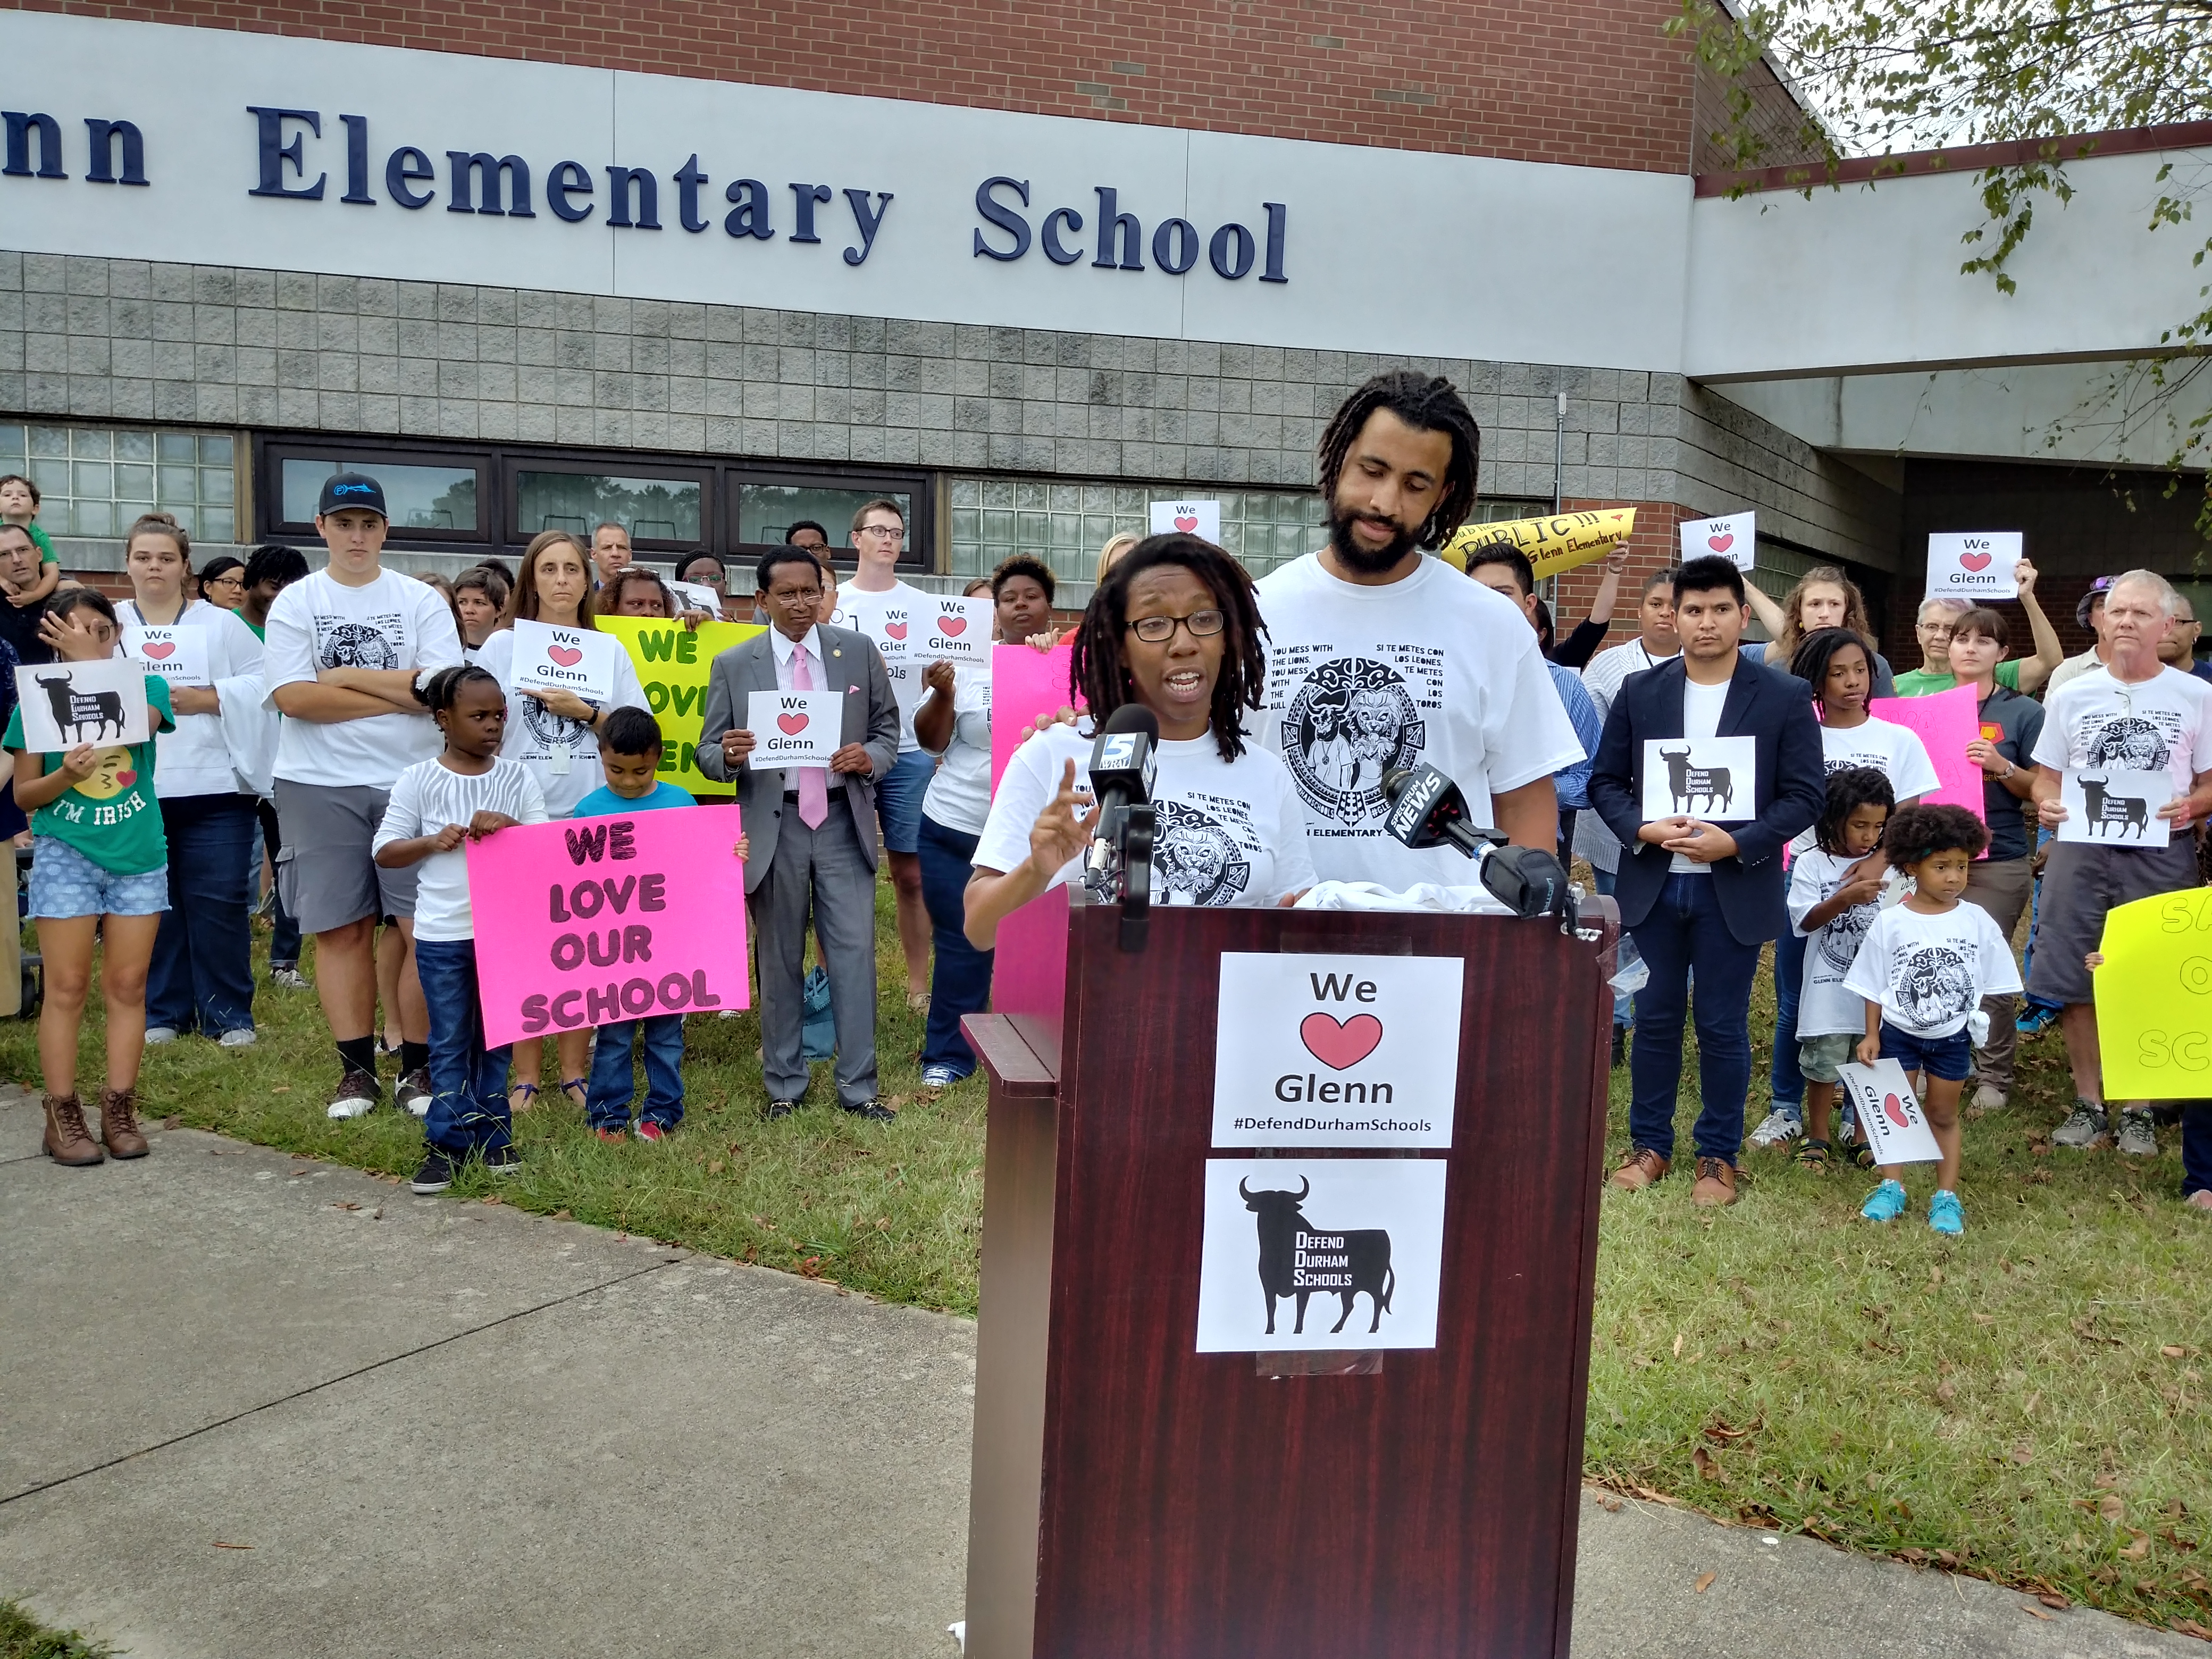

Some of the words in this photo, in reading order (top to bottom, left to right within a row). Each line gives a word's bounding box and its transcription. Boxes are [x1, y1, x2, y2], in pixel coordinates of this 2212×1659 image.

[246, 106, 895, 266] Elementary
[973, 175, 1289, 283] School
[1176, 505, 1196, 514] We
[1710, 522, 1731, 533] We
[1526, 547, 1564, 565] Glenn
[1567, 530, 1622, 553] Elementary
[1964, 539, 1990, 549] We
[1949, 573, 1996, 584] Glenn
[940, 601, 965, 614] We
[886, 610, 908, 619] We
[145, 631, 172, 639] We
[552, 631, 581, 645] We
[638, 629, 699, 665] WE
[928, 638, 971, 651] Glenn
[1272, 647, 1287, 657] YOU
[1289, 646, 1310, 655] MESS
[1312, 644, 1334, 653] WITH
[1398, 644, 1426, 655] METES
[1427, 648, 1445, 657] CON
[914, 652, 984, 663] #DefendDurhamSchools
[1412, 656, 1444, 668] LEONES,
[537, 665, 587, 682] Glenn
[1271, 668, 1287, 678] YOU
[1287, 667, 1309, 676] MESS
[1417, 667, 1444, 677] METES
[520, 676, 604, 696] #DefendDurhamSchools
[1271, 678, 1290, 688] WITH
[1426, 678, 1444, 688] CON
[1270, 691, 1284, 699] THE
[1428, 689, 1443, 698] LOS
[781, 697, 807, 709] We
[1270, 701, 1286, 710] BULL
[1415, 699, 1443, 709] TOROS
[767, 738, 814, 750] Glenn
[1103, 735, 1135, 760] 5
[755, 754, 831, 763] #DefendDurhamSchools
[1100, 759, 1130, 769] WRAL
[1685, 785, 1714, 793] SCHOOLS
[1197, 792, 1207, 801] TE
[1209, 795, 1235, 807] METES
[1237, 800, 1251, 811] CON
[1206, 804, 1222, 812] LOS
[1390, 780, 1421, 828] SPECTRUM
[1395, 772, 1441, 841] NEWS
[53, 799, 86, 824] I'M
[94, 791, 147, 826] IRISH
[2101, 805, 2127, 813] DURHAM
[2100, 812, 2129, 820] SCHOOLS
[1247, 834, 1260, 844] LOS
[1313, 829, 1384, 837] ELEMENTARY
[564, 820, 637, 866] WE
[1238, 841, 1263, 853] TOROS
[549, 873, 666, 923] LOVE
[550, 924, 652, 971] OUR
[1310, 972, 1378, 1003] We
[521, 969, 721, 1033] SCHOOL
[1274, 1073, 1394, 1104] Glenn
[1846, 1072, 1884, 1155] #DefendDurhamSchools
[1865, 1085, 1890, 1136] Glenn
[1902, 1095, 1918, 1125] We
[1233, 1117, 1432, 1133] #DefendDurhamSchools
[1295, 1230, 1345, 1250] DEFEND
[1294, 1250, 1349, 1269] DURHAM
[1293, 1268, 1352, 1287] SCHOOLS
